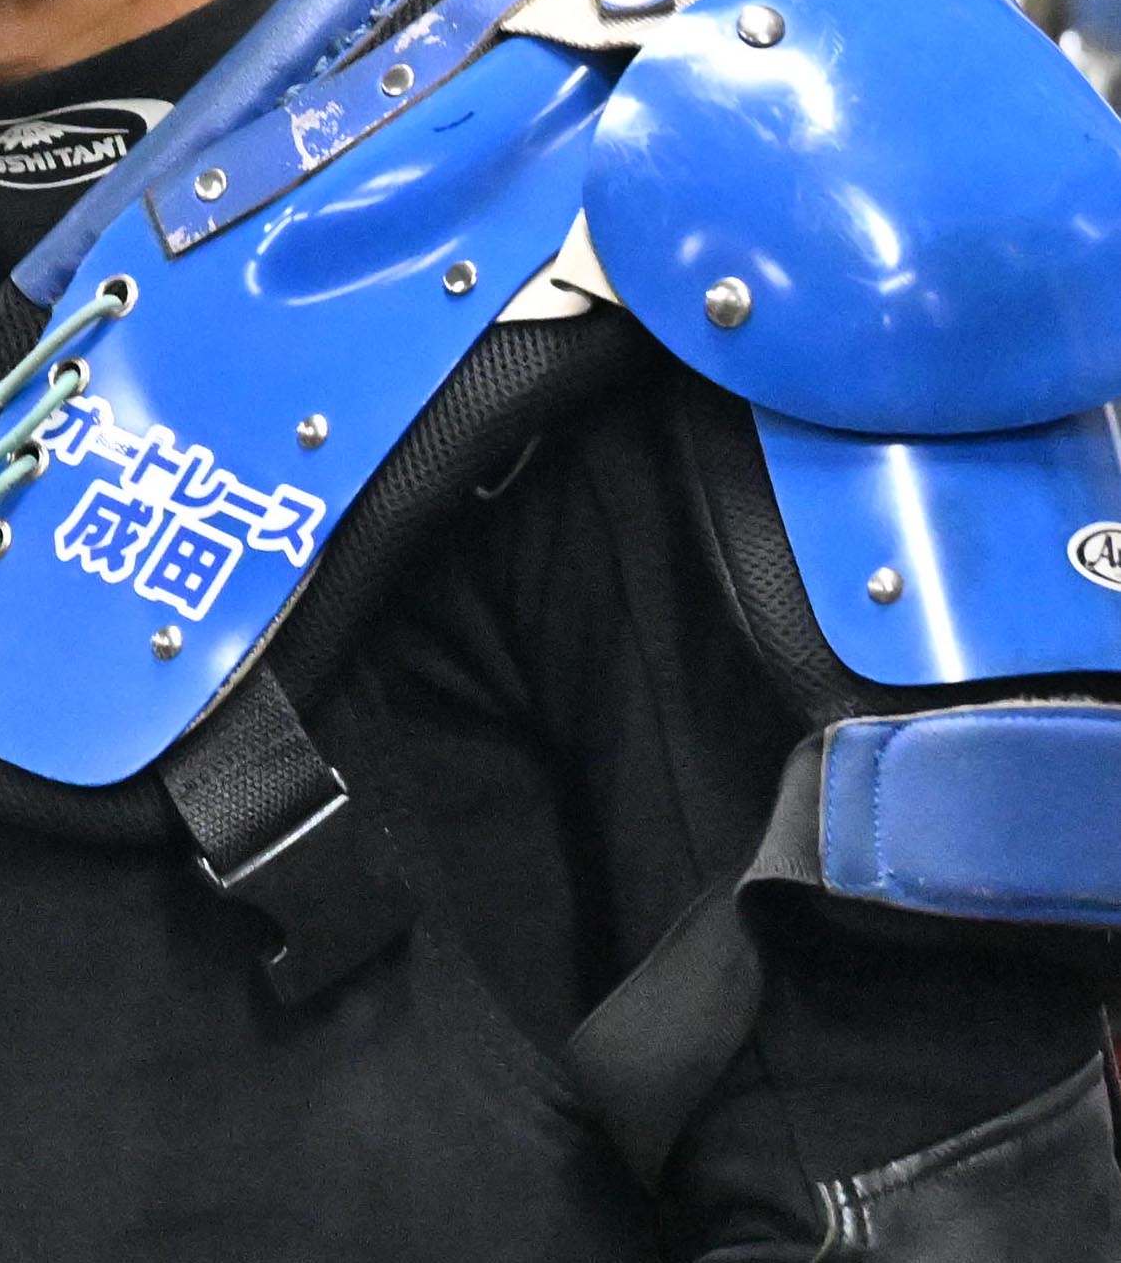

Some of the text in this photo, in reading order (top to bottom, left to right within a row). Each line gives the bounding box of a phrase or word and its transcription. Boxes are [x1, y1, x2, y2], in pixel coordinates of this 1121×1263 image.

[33, 396, 326, 568] オートレース
[54, 479, 243, 621] 成田
